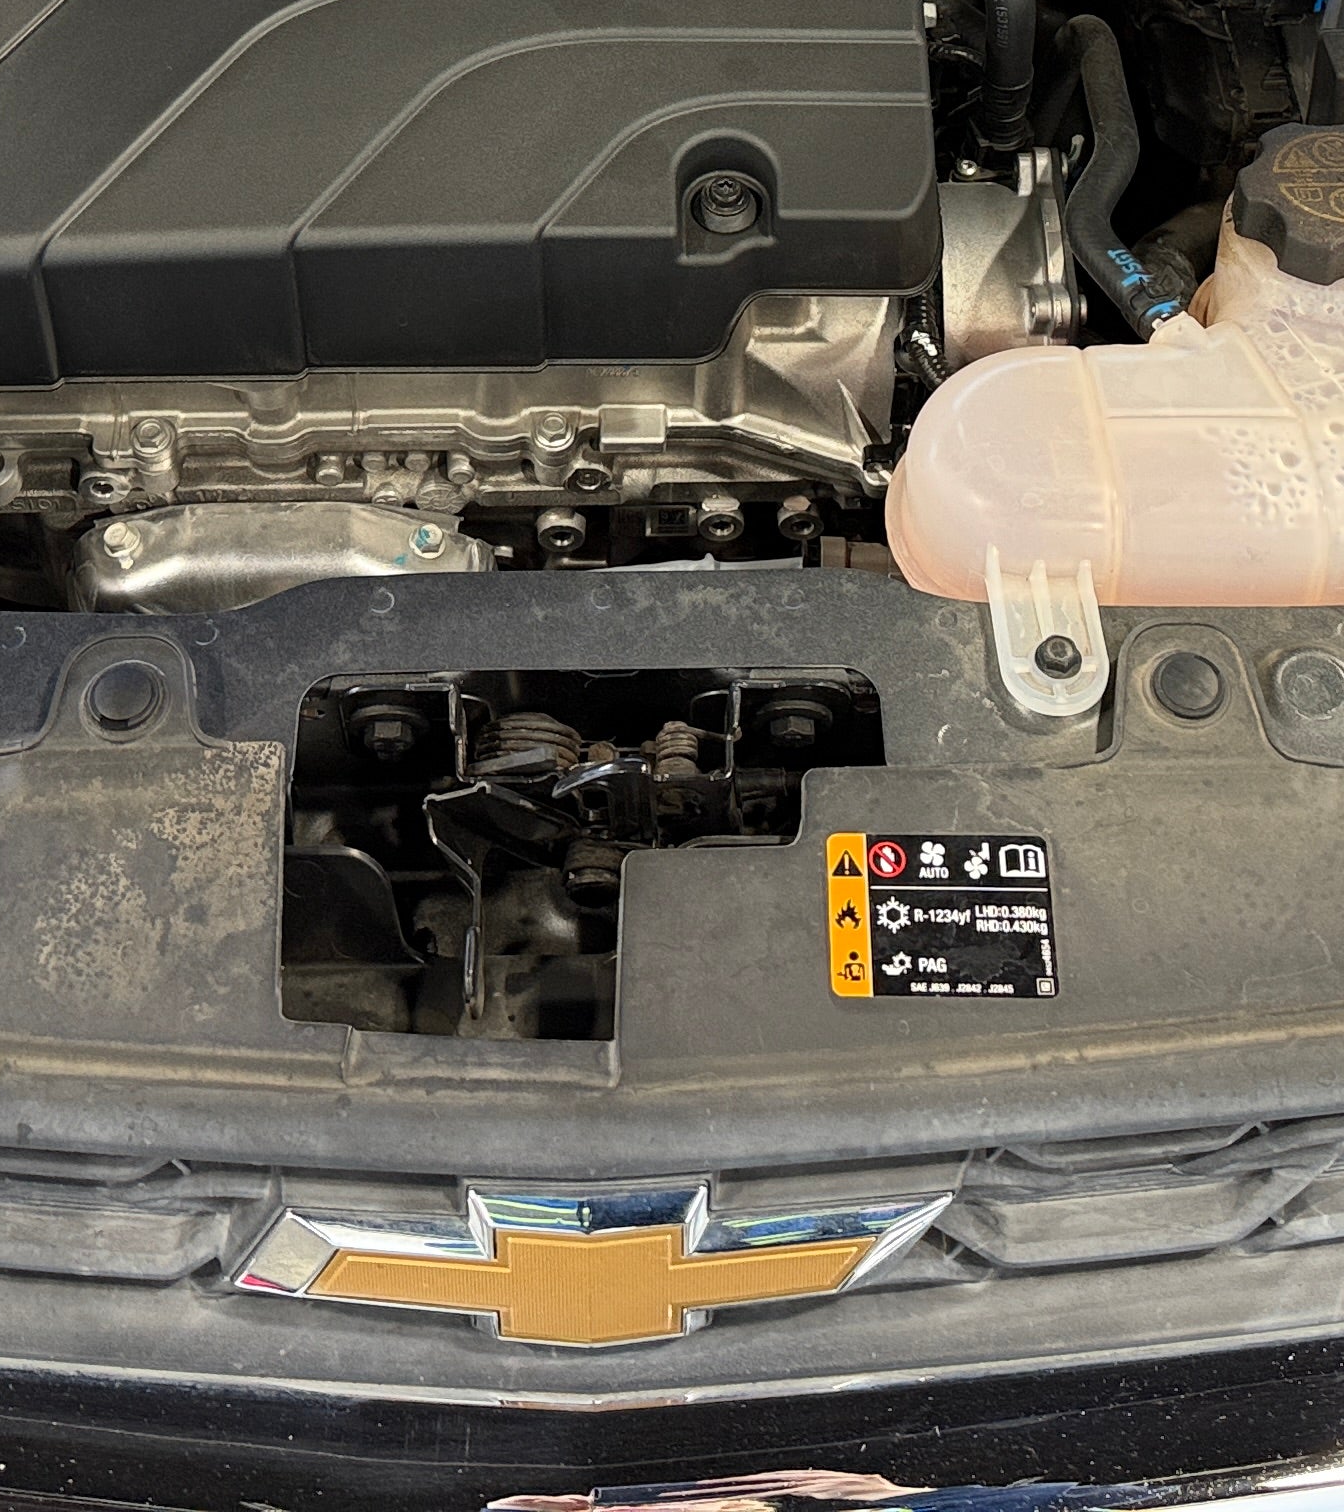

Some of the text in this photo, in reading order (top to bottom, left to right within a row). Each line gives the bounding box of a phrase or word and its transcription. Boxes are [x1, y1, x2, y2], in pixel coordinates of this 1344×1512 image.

[919, 866, 949, 879] AUTO
[913, 905, 1047, 926] R-1234yf LHD:0.380kg
[976, 920, 1049, 935] RHD:0.430kg
[918, 957, 947, 973] PAG
[910, 982, 928, 993] SAE
